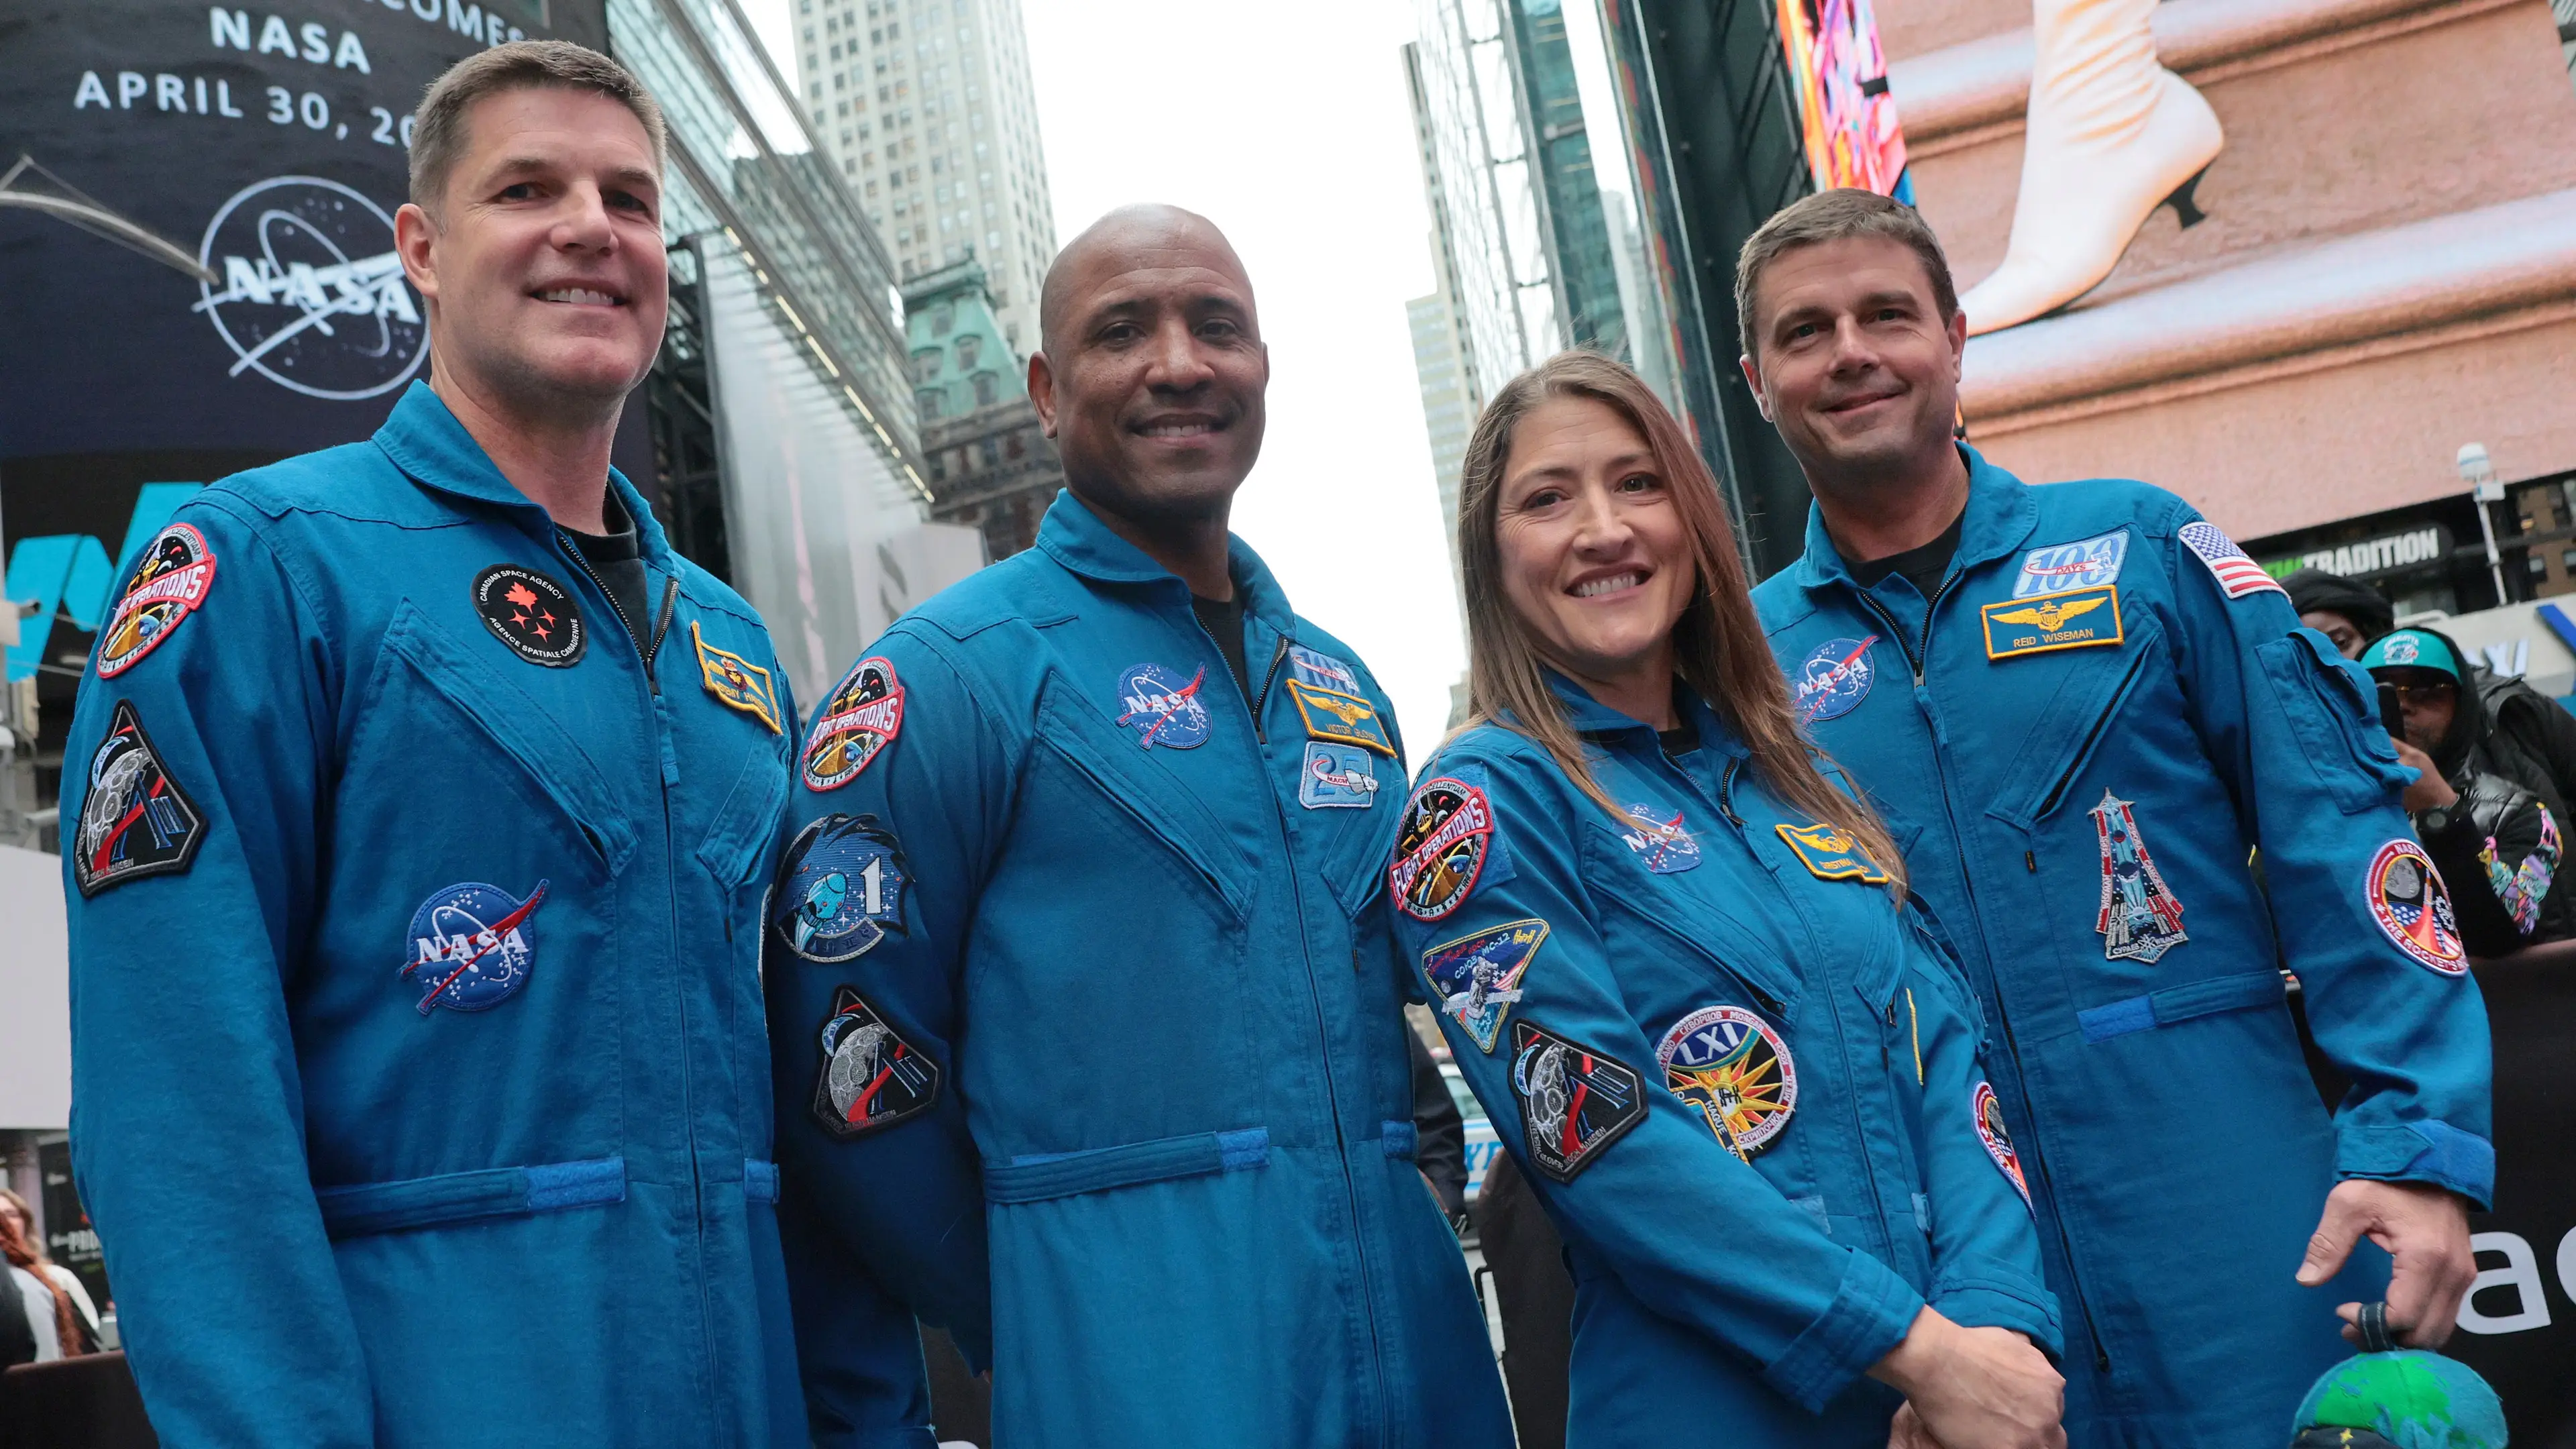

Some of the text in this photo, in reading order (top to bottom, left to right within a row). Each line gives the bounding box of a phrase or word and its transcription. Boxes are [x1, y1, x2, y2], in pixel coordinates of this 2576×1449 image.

[210, 7, 371, 75] NASA
[363, 0, 524, 47] OME
[74, 70, 243, 119] APRIL
[267, 85, 348, 140] 30,
[224, 255, 421, 323] NASA
[2021, 537, 2120, 594] 100
[2055, 564, 2086, 575] DAYS
[2302, 527, 2439, 578] TRADITION
[134, 565, 207, 606] OPERATIONS
[480, 570, 564, 602] CANADIAN SPACE AGENCY
[490, 617, 580, 658] AGENCE SPATIALE CANADIENNE
[2013, 628, 2094, 647] REID WISEMAN
[1798, 657, 1869, 698] NASA
[836, 698, 898, 731] OPERATIONS
[1124, 694, 1206, 714] NASA
[1325, 724, 1352, 735] VICTOR
[1327, 775, 1348, 786] MACH
[1421, 782, 1466, 796] EXCELLENTIAM
[1392, 853, 1421, 900] FLIGHT
[1421, 797, 1487, 861] OPERATIONS
[2394, 843, 2420, 857] NASA
[859, 856, 882, 914] 1
[416, 927, 530, 965] NASA
[2382, 916, 2405, 940] THE
[2403, 939, 2459, 971] ROCKETS
[1729, 1011, 1764, 1032] MORGAN
[1678, 1022, 1740, 1065] LXI
[1705, 1100, 1727, 1135] HAGUE
[1540, 1153, 1564, 1171] GLOVER
[1580, 1126, 1607, 1150] HANSEN
